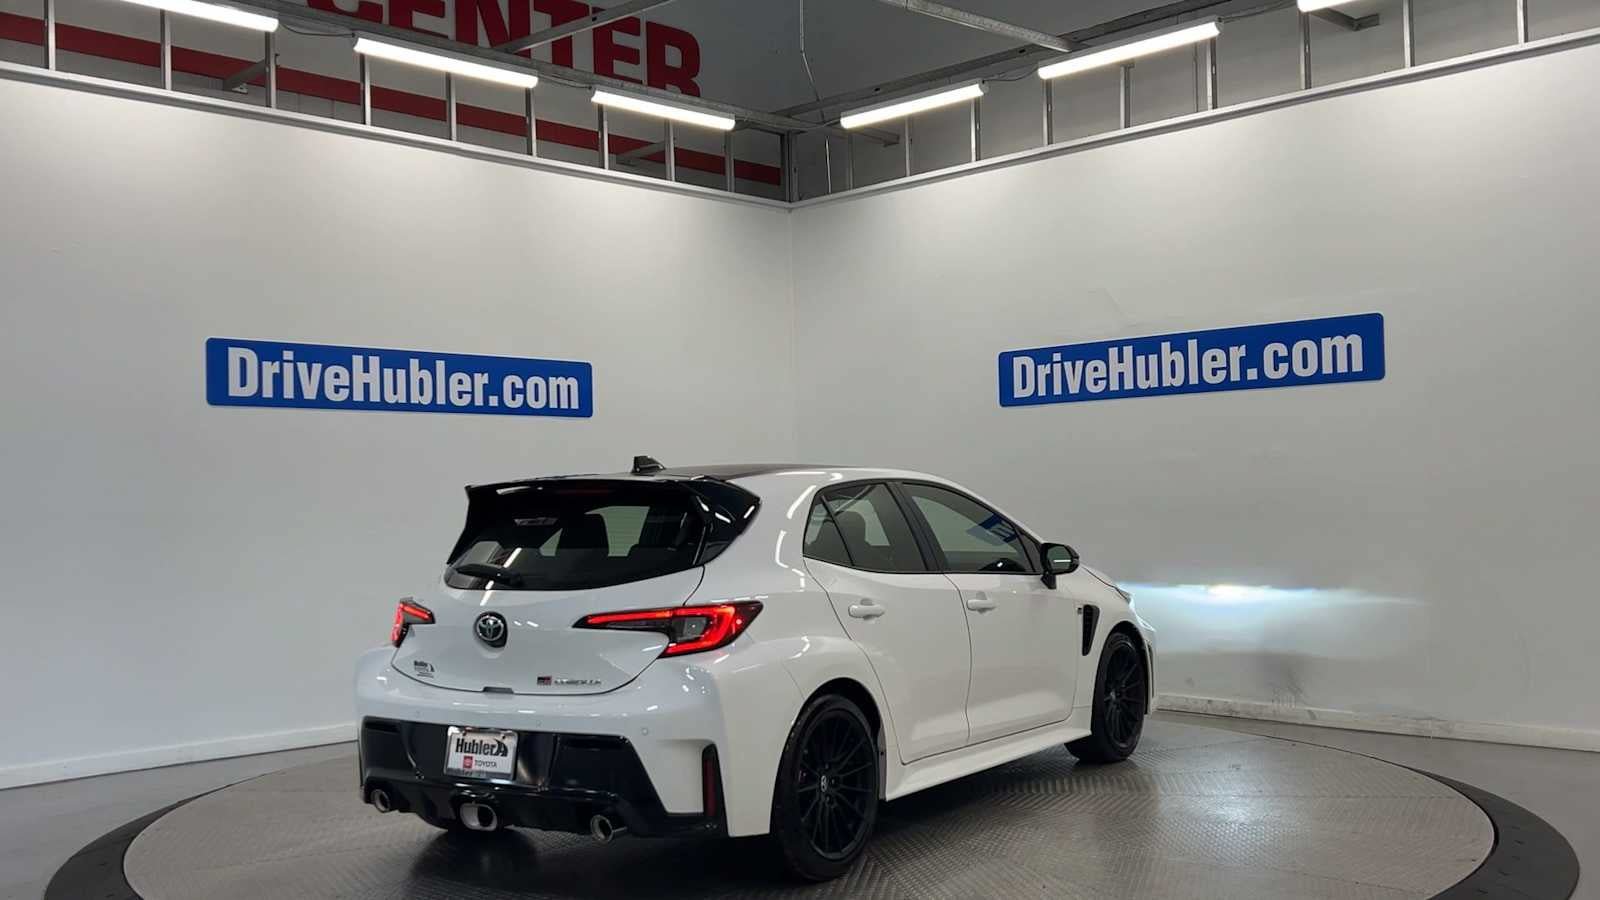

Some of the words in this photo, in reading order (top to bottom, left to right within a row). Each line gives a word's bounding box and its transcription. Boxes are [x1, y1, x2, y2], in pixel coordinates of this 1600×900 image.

[307, 0, 702, 98] NTER
[227, 346, 580, 410] DriveHubler.com
[1012, 332, 1364, 399] DriveHubler.com
[455, 738, 499, 756] Hubler
[475, 760, 497, 768] TOYOTA
